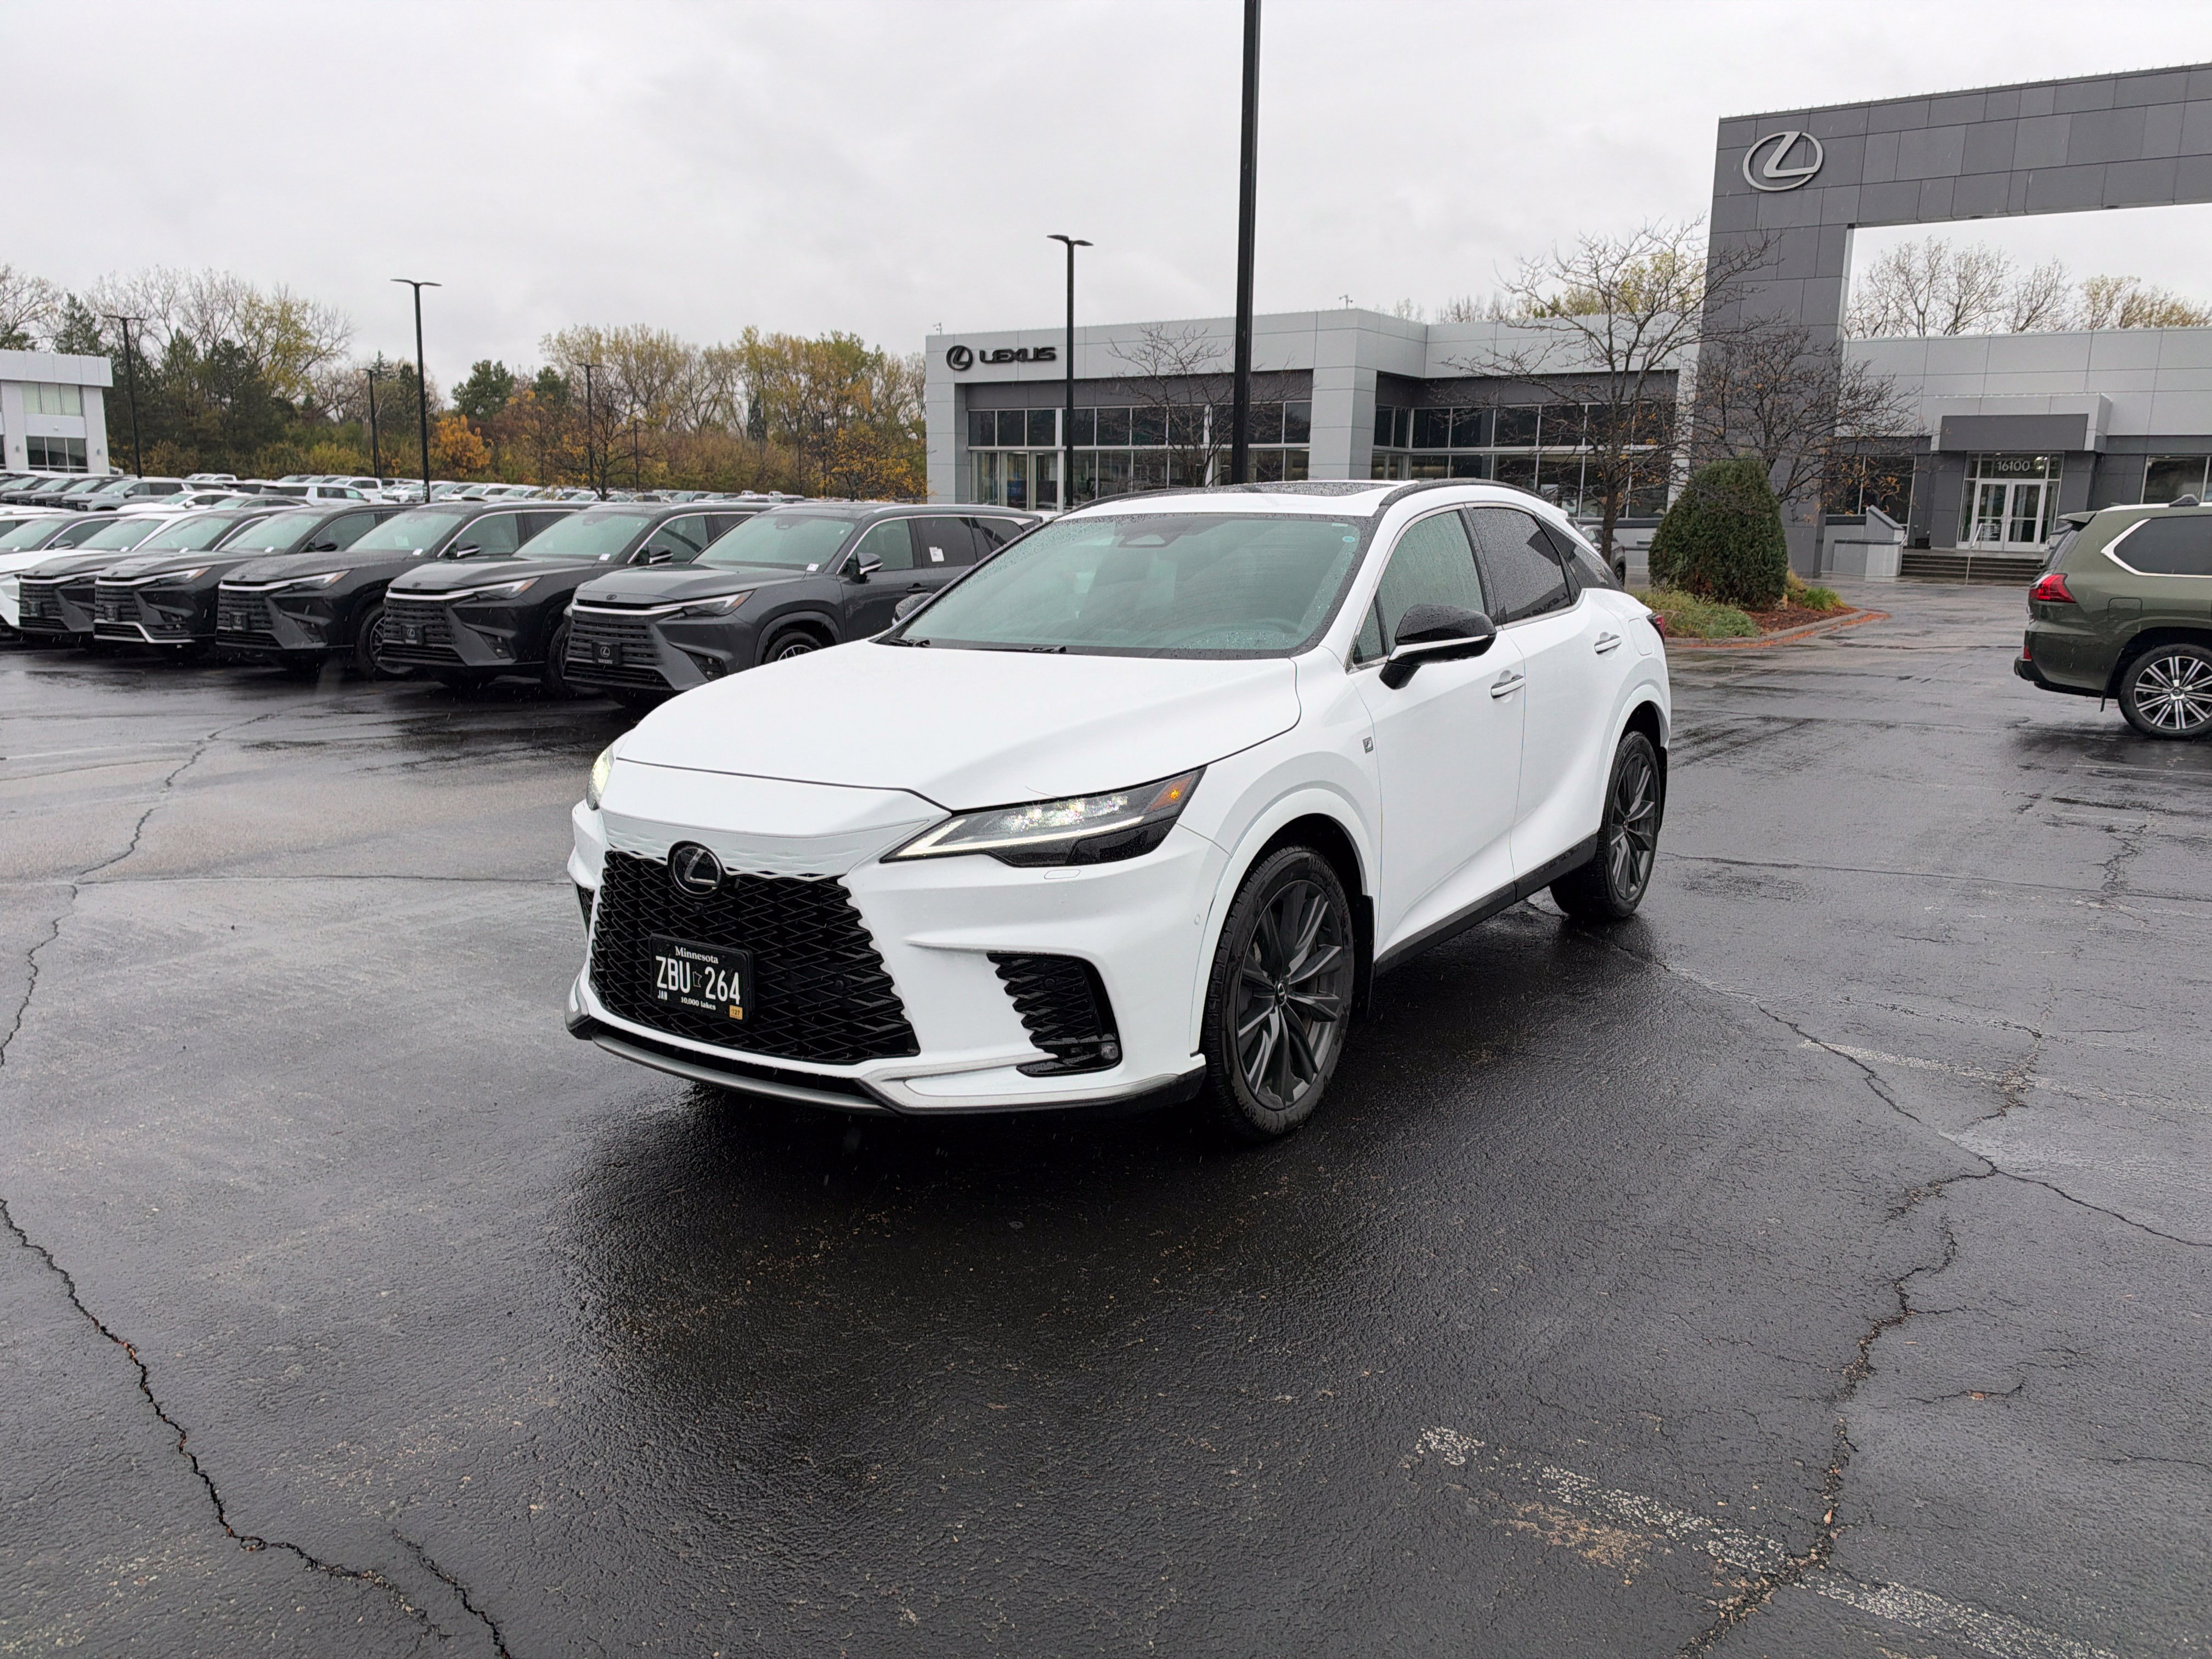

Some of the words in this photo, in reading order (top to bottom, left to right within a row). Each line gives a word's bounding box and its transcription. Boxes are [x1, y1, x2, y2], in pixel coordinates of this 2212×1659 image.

[979, 347, 1057, 364] LEXUS
[1997, 460, 2030, 472] 16100
[675, 946, 719, 964] Minnesota
[656, 956, 691, 994] ZBU
[705, 966, 740, 1005] 264
[658, 990, 667, 1001] JAN
[681, 996, 699, 1007] 10,000
[701, 1000, 716, 1011] lakes
